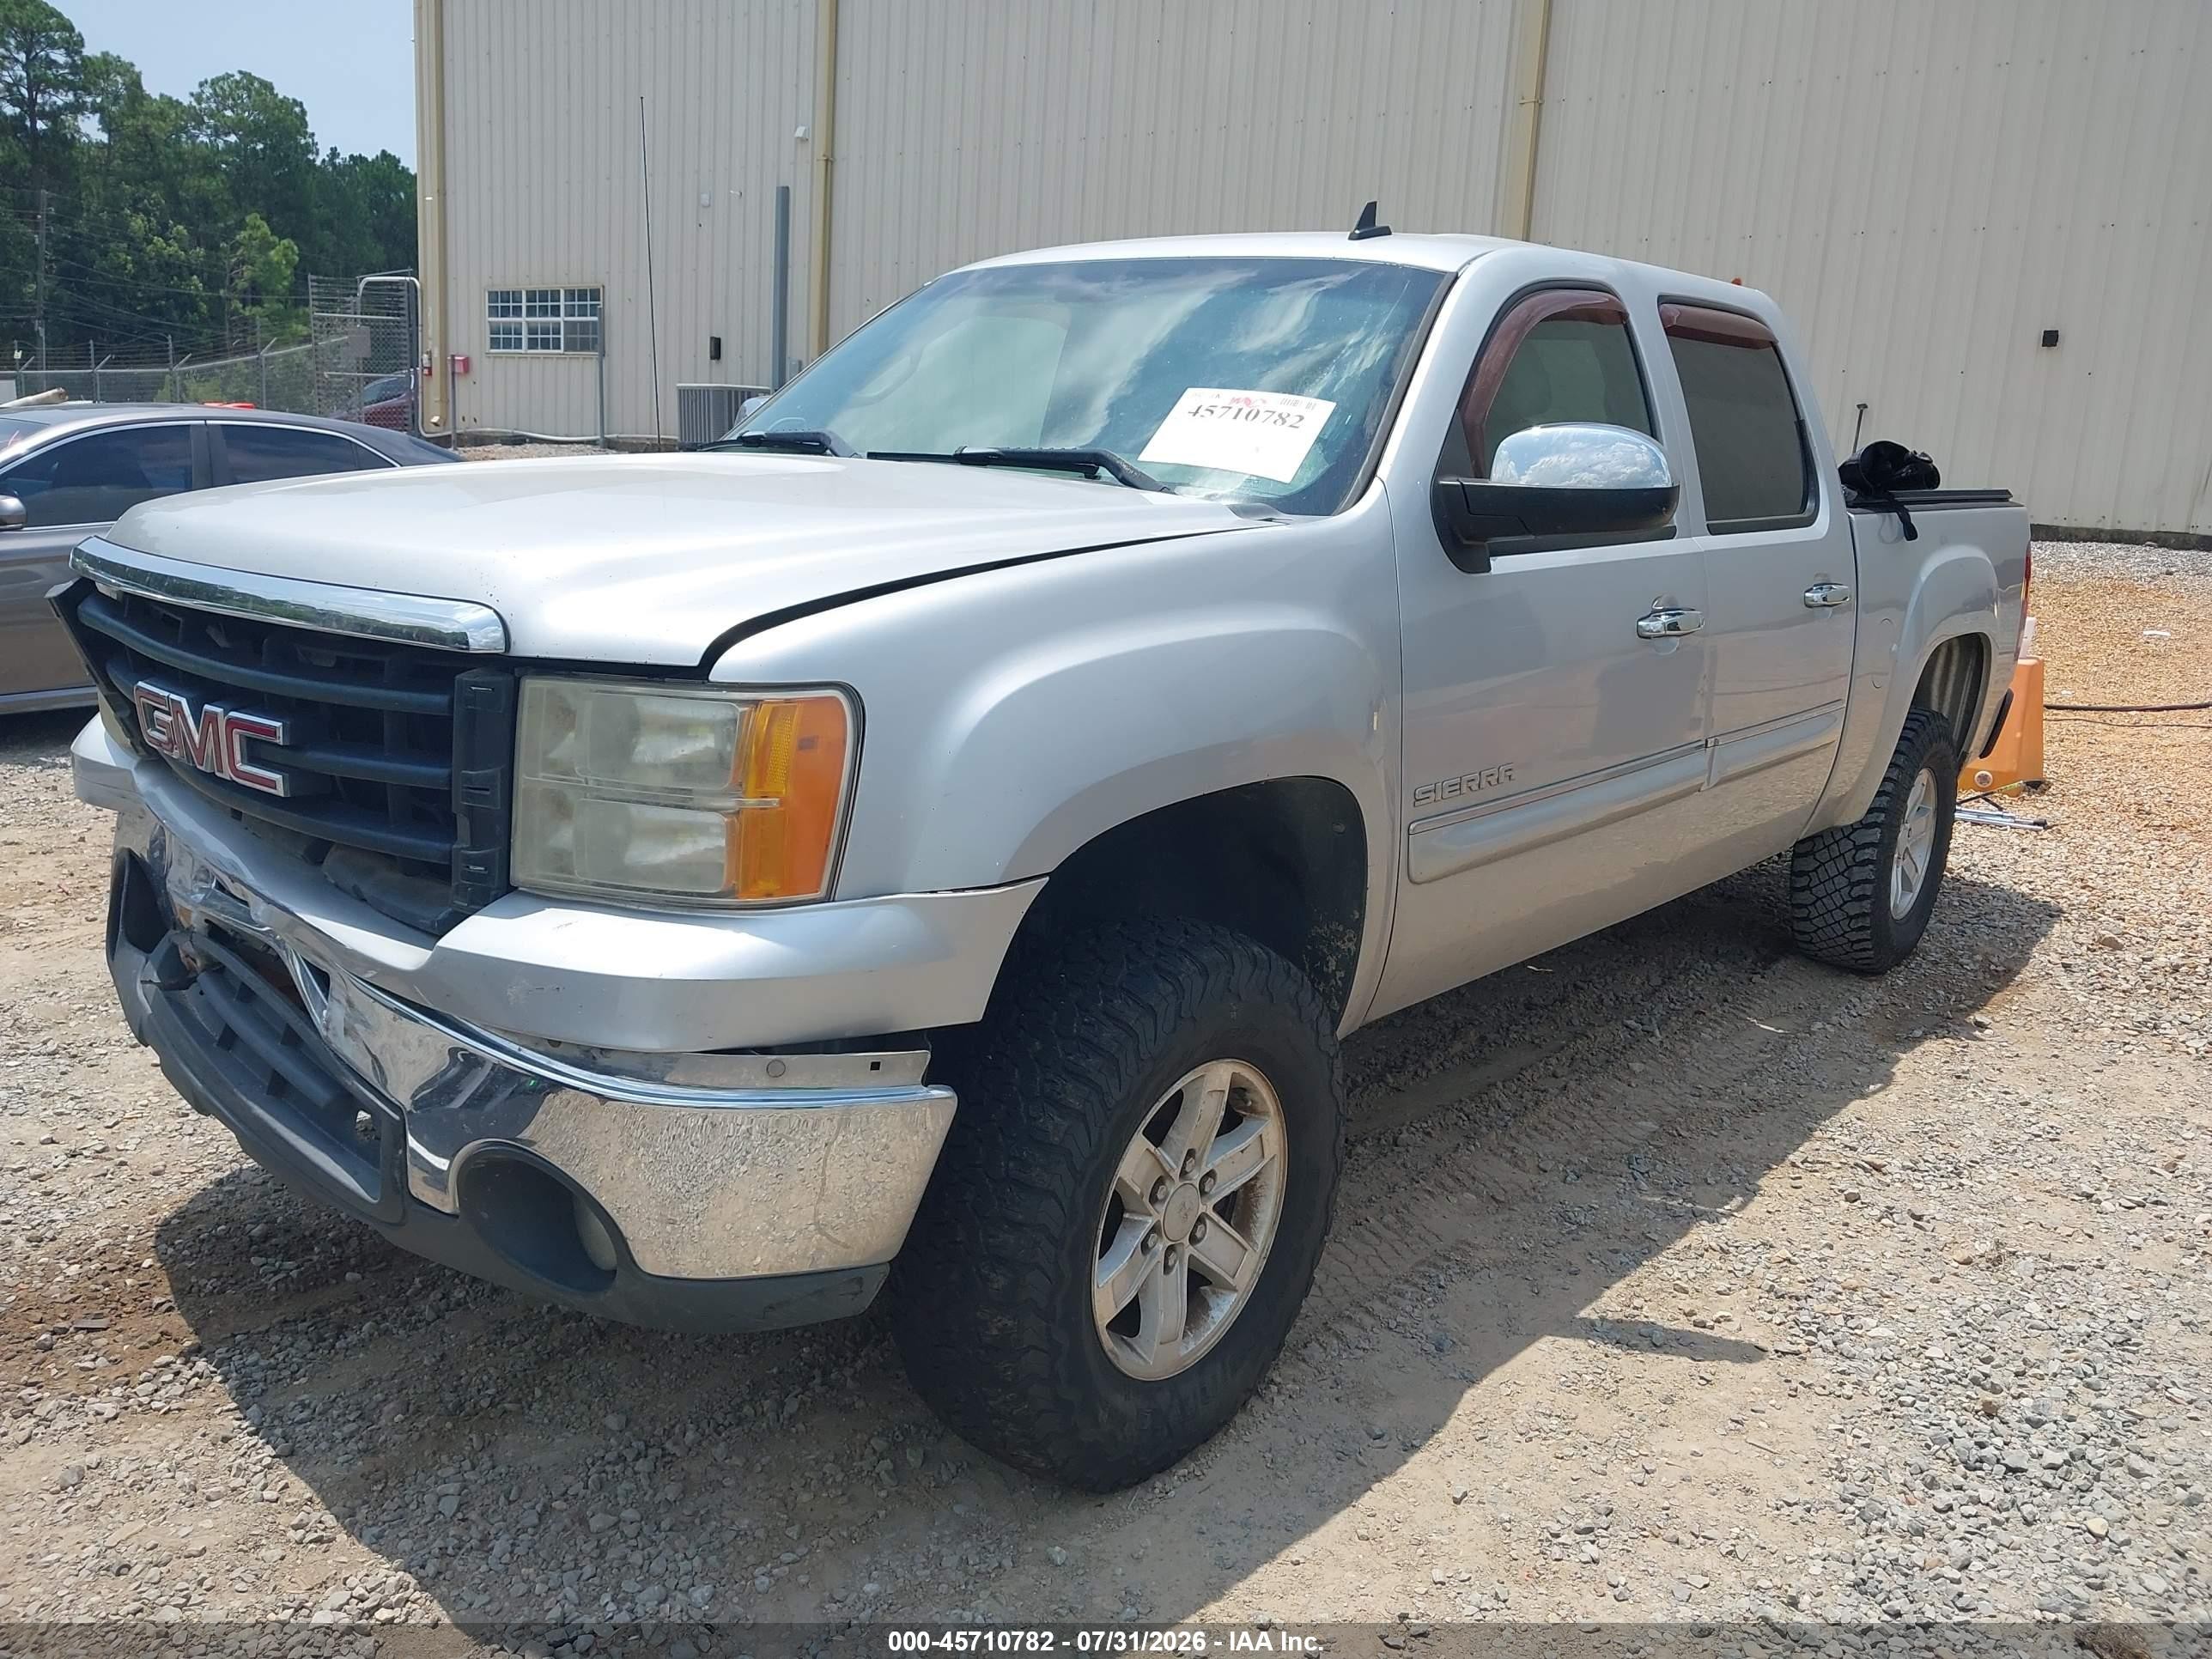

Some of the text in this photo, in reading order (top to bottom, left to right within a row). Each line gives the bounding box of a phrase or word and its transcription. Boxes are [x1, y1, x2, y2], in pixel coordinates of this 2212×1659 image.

[1188, 404, 1305, 429] 45710782
[134, 681, 289, 797] GMC
[1413, 762, 1516, 808] SIERRA
